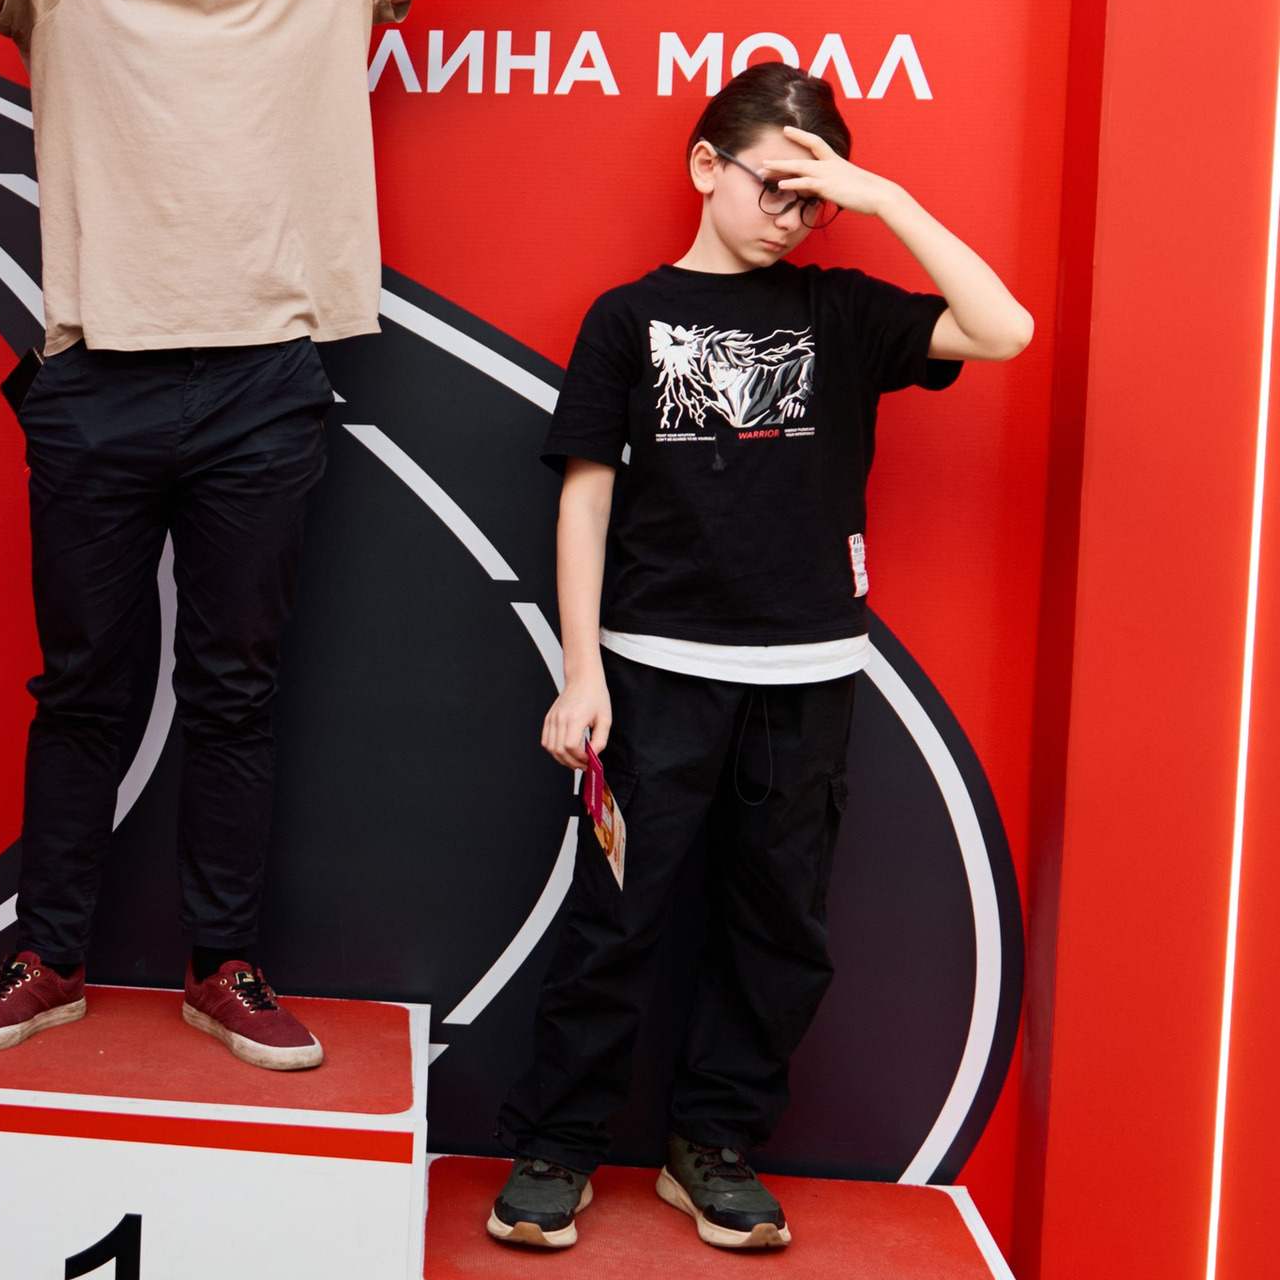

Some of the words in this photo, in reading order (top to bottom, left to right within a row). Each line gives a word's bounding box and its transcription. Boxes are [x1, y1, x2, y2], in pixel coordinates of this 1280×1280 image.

[368, 29, 620, 96] ЛИНА
[657, 32, 933, 100] МОЛЛ
[738, 429, 779, 440] WARRIOR
